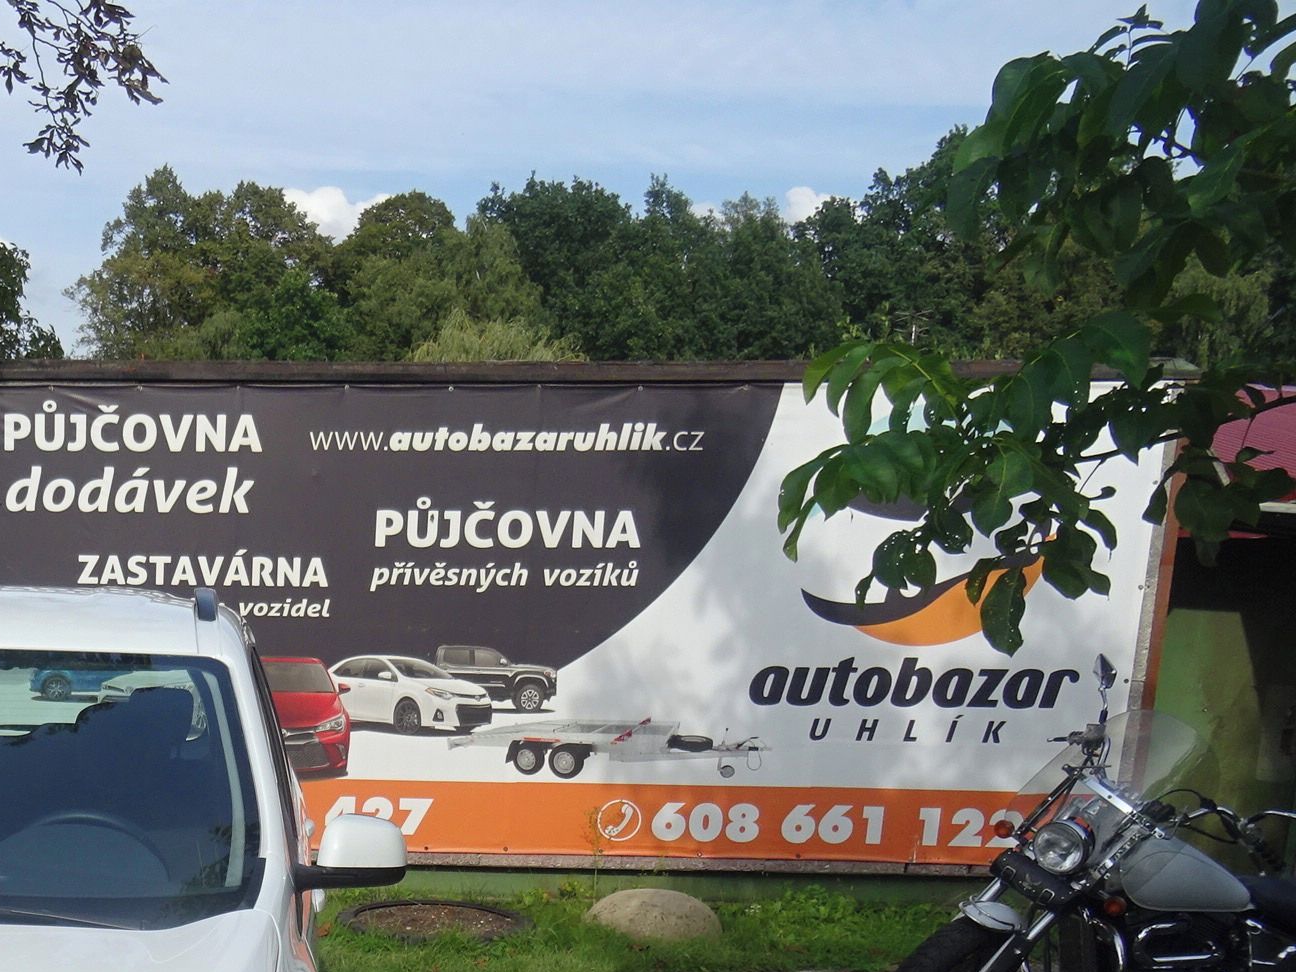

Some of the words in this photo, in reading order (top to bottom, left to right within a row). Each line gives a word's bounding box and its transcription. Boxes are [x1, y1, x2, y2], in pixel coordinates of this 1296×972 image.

[3, 400, 263, 452] PŮJČOVNA
[309, 422, 705, 452] www.autobazaruhlik.cz
[5, 465, 255, 513] dodávek
[373, 496, 641, 548] PŮJČOVNA
[77, 549, 329, 588] ZASTAVÁRNA
[369, 562, 528, 592] přívěsných
[543, 560, 640, 588] vozíků
[238, 597, 331, 618] vozidel
[748, 656, 1081, 710] autobazar
[808, 714, 1007, 744] UHLÍK
[650, 801, 761, 843] 608
[780, 803, 886, 845] 661
